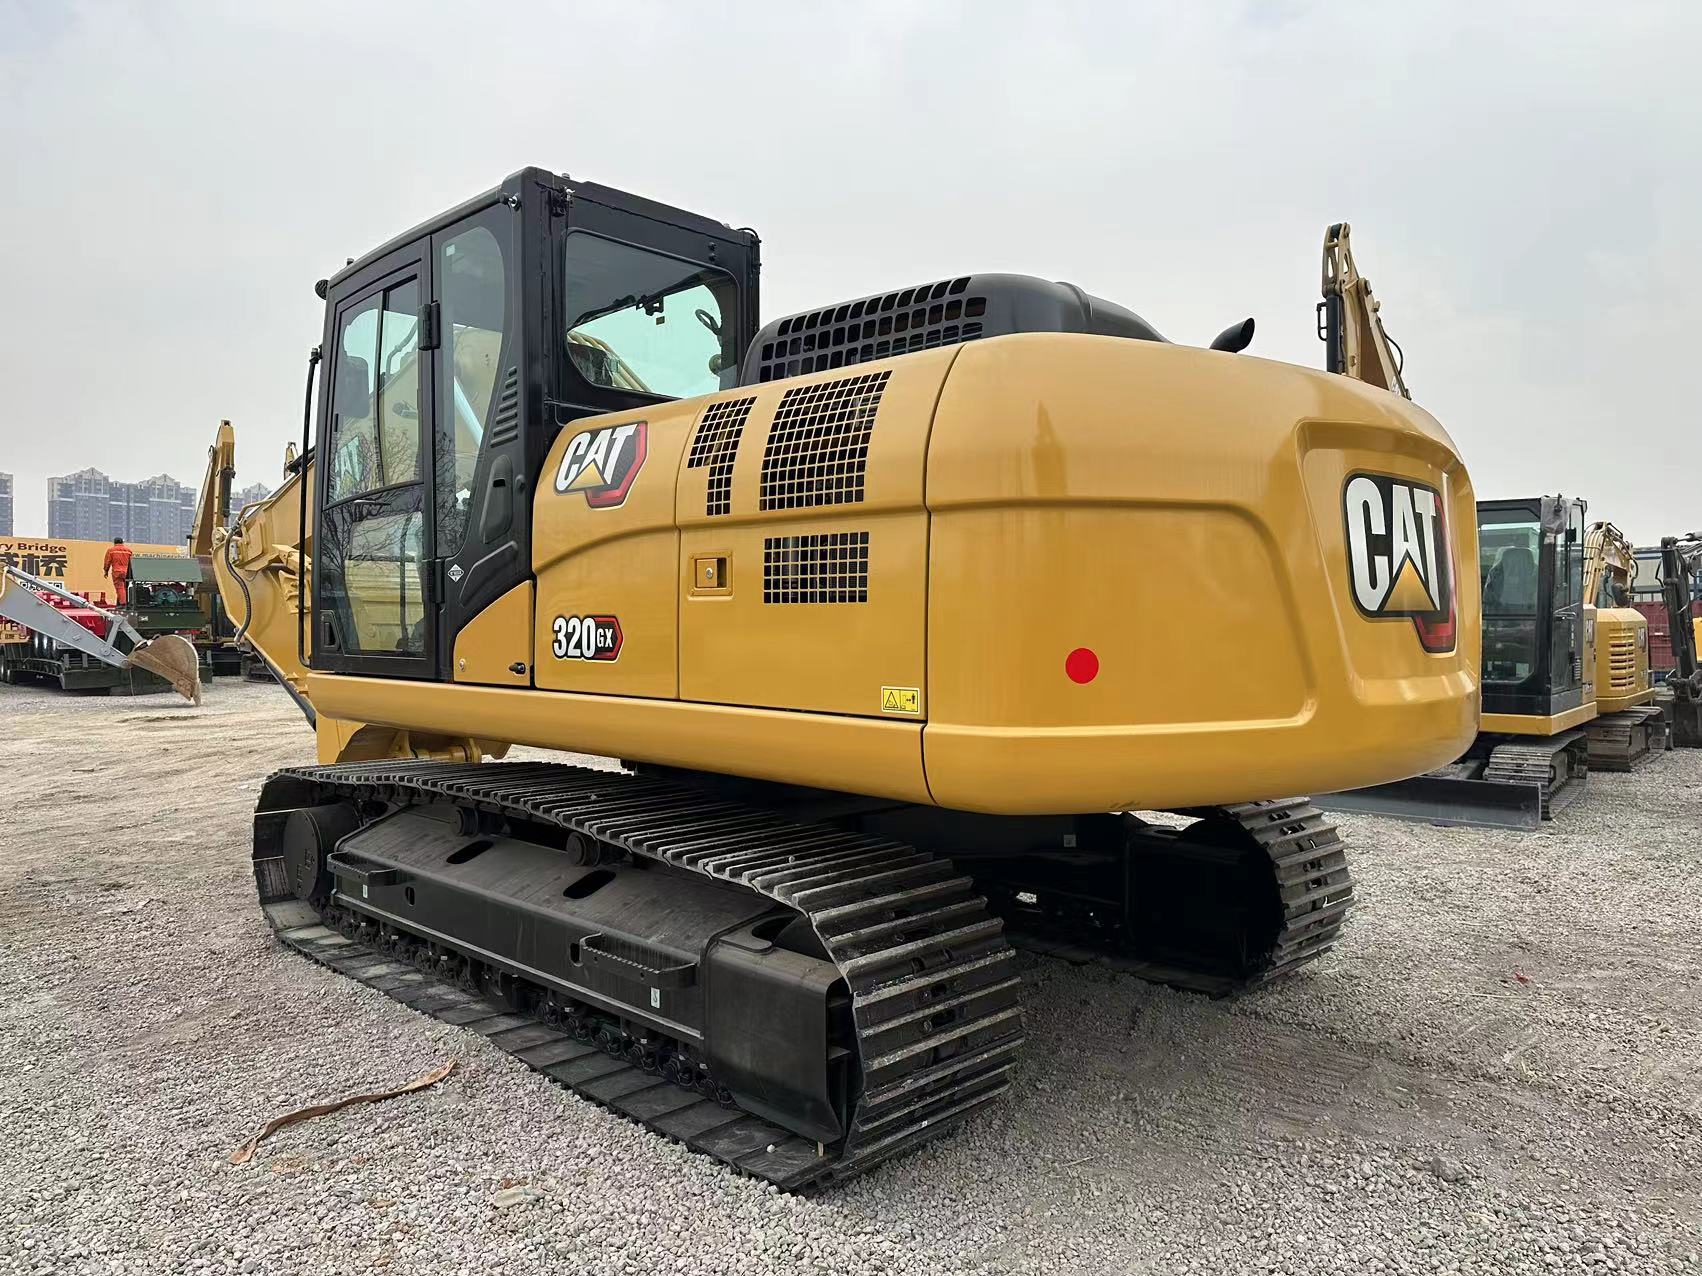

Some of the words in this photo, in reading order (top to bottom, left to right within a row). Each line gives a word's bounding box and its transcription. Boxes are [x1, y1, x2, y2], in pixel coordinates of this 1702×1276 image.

[556, 424, 638, 491] CAT
[17, 543, 67, 553] Bridge
[1346, 477, 1441, 611] CAT
